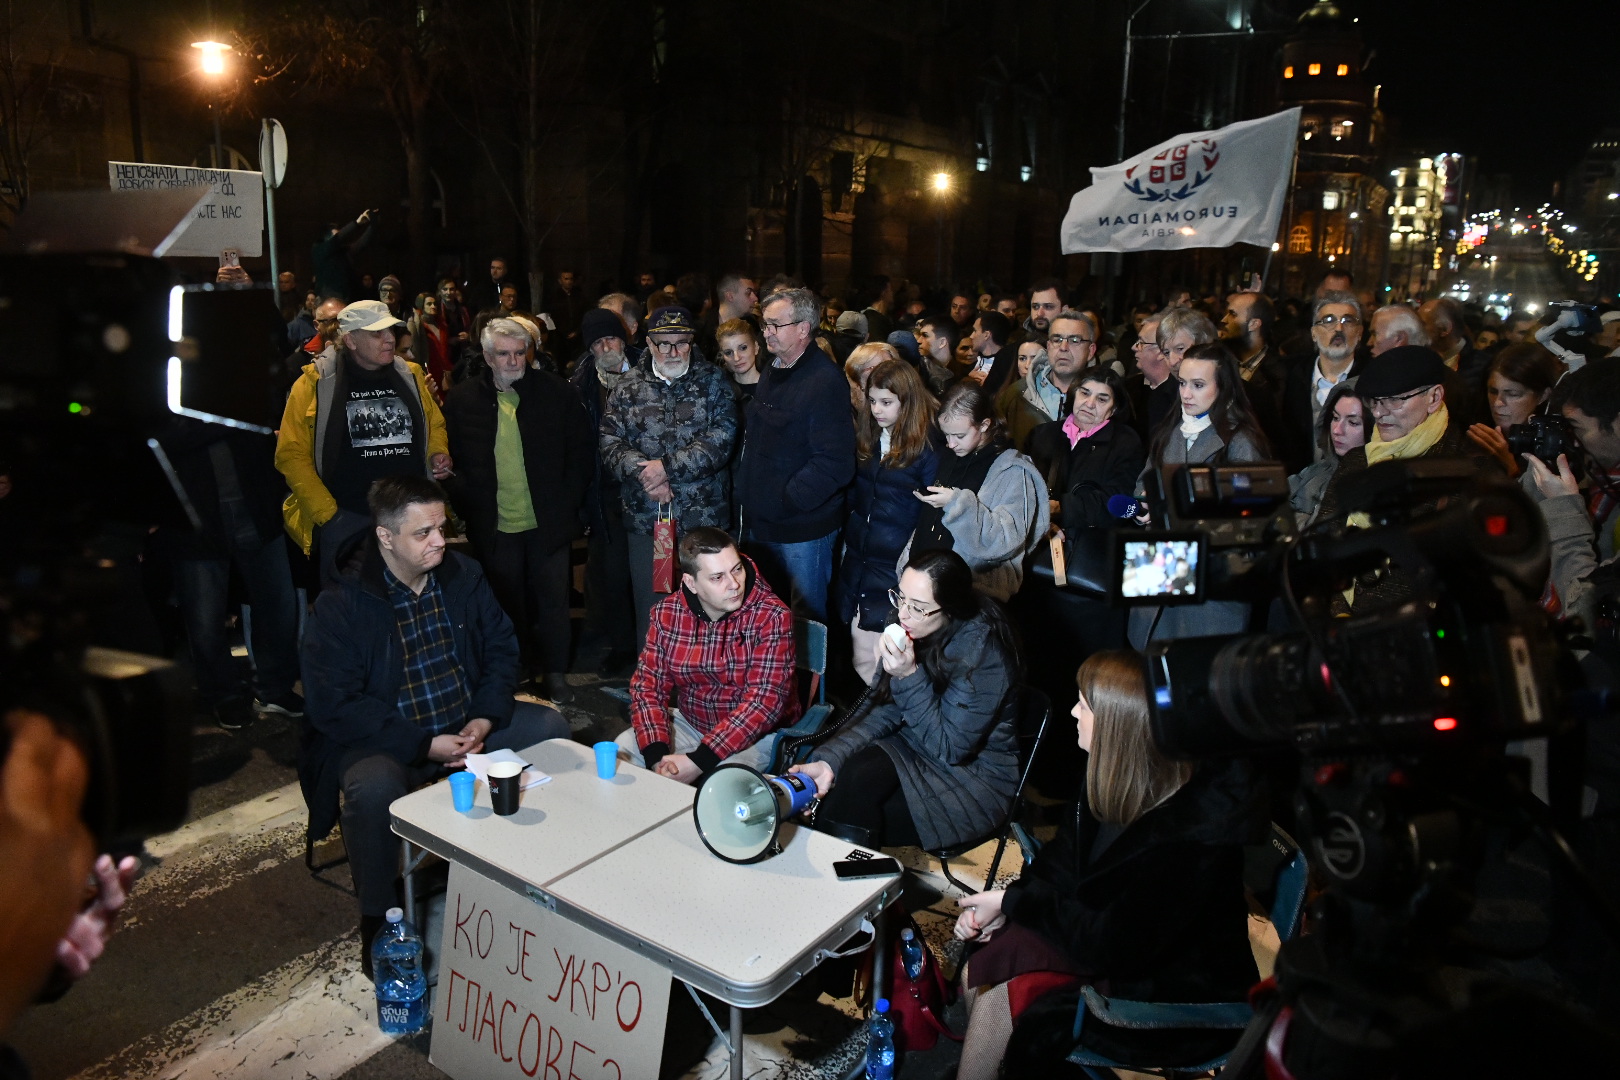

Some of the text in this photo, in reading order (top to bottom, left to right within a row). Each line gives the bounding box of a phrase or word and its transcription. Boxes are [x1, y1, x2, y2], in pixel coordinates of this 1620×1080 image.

[117, 165, 231, 184] НЕПОЗНАТИ ГЛАСАЧИ
[221, 183, 236, 197] ОД
[221, 205, 242, 219] НАС
[1272, 839, 1288, 856] QUEC
[454, 893, 643, 1032] КО ЈЕ УКР'О
[382, 1014, 408, 1024] viva
